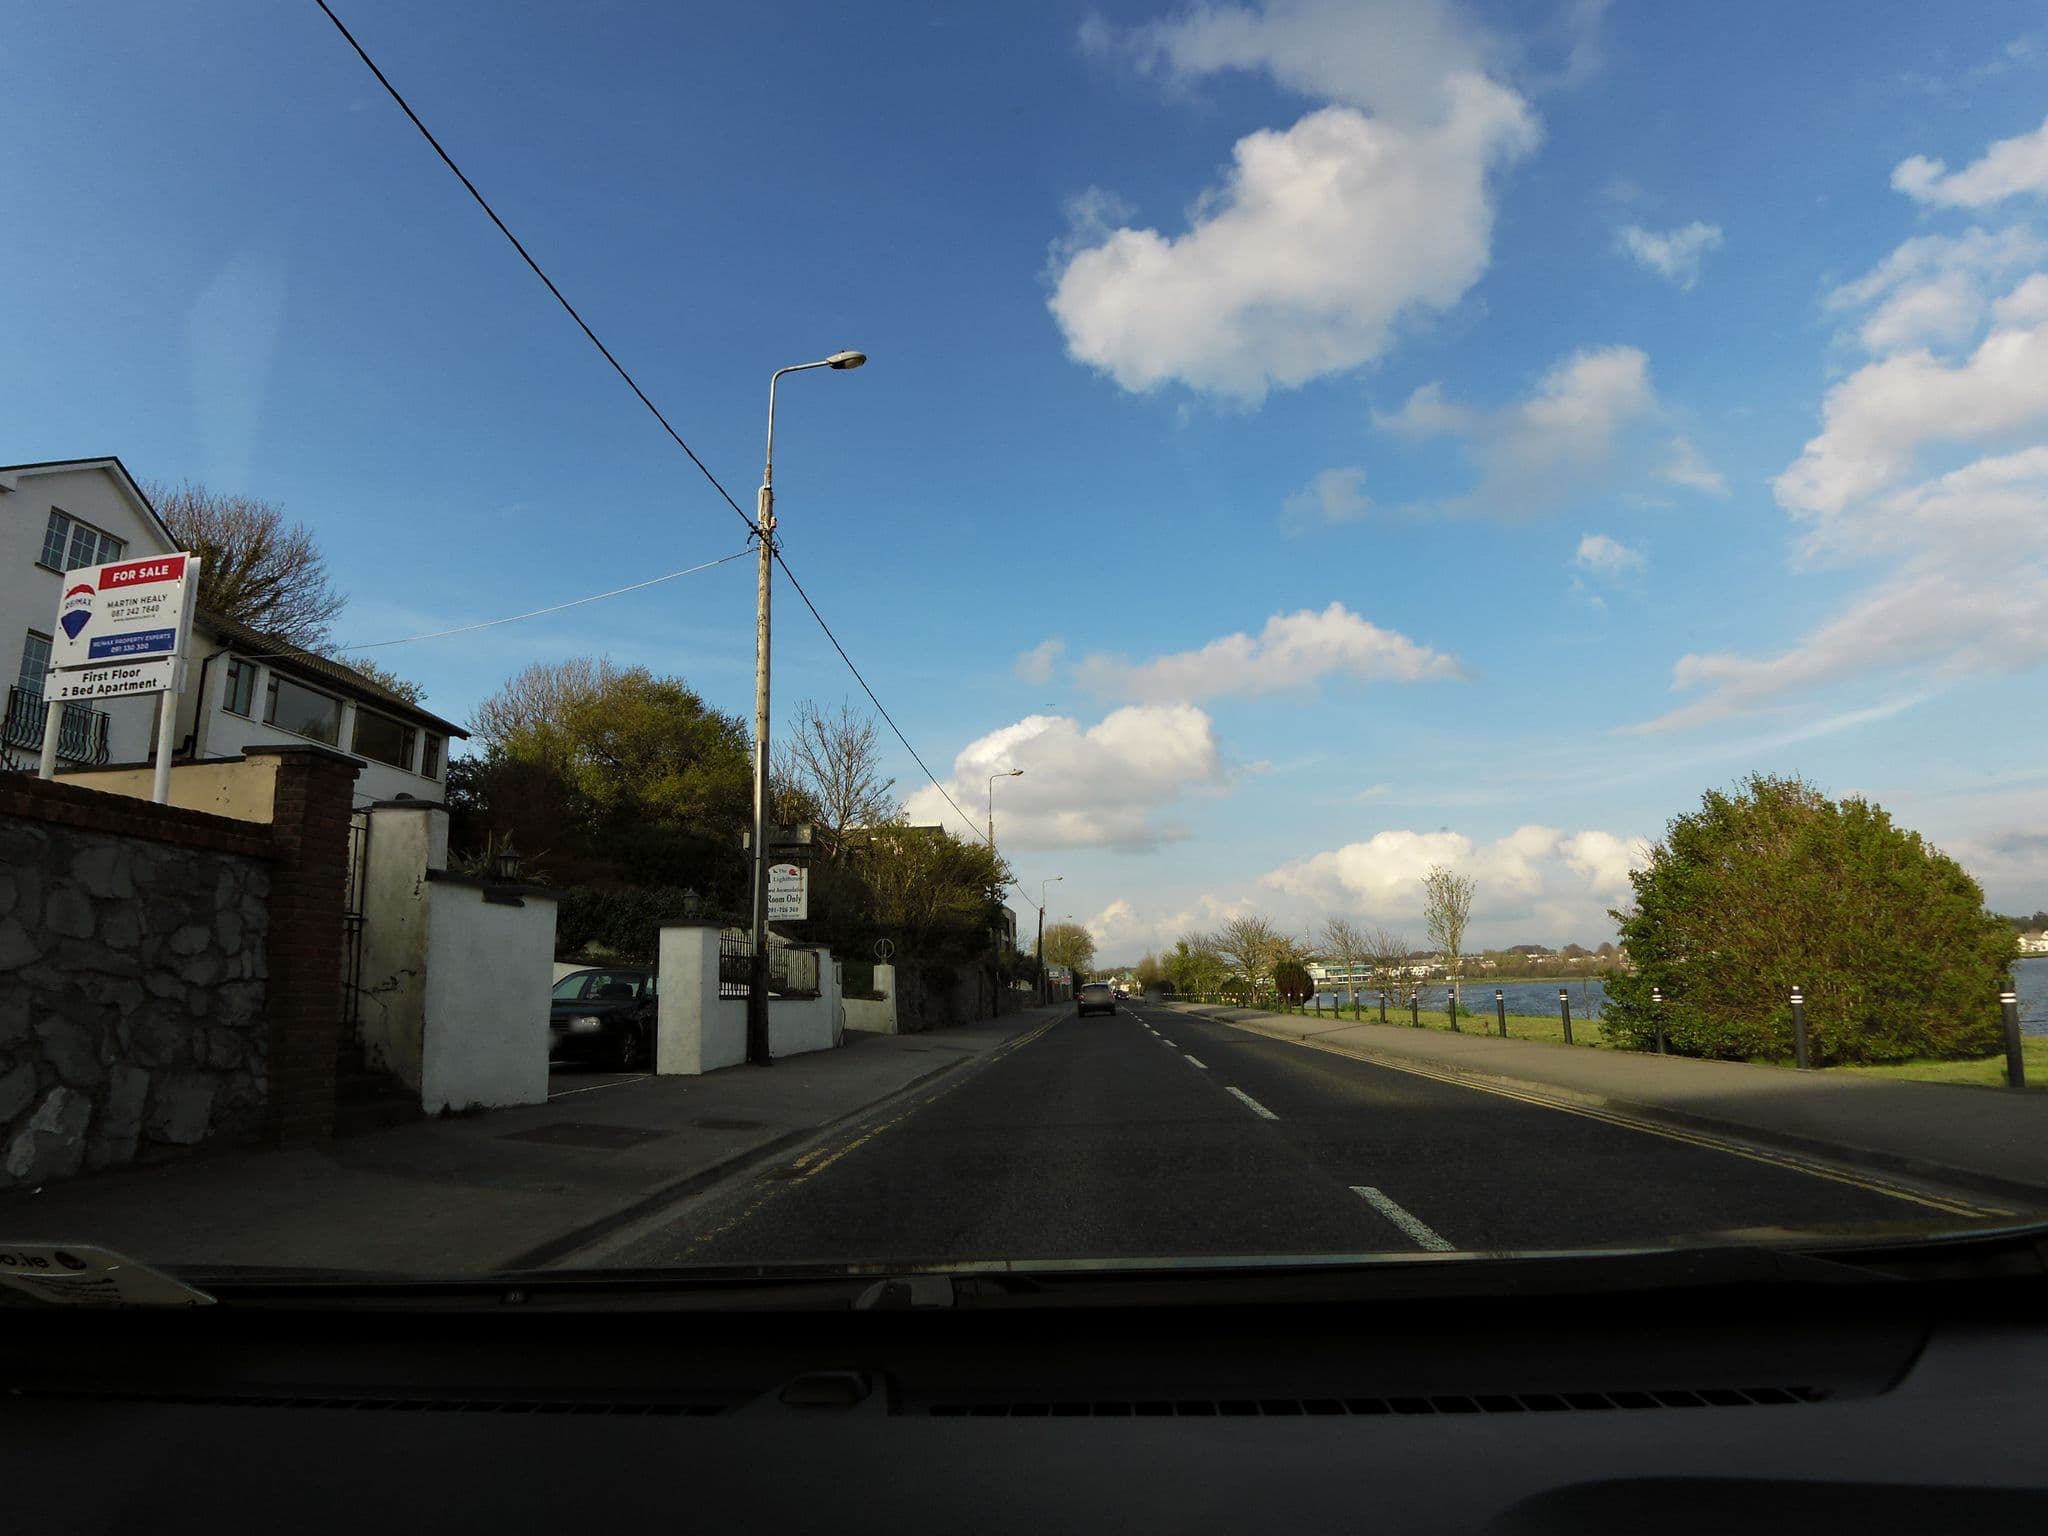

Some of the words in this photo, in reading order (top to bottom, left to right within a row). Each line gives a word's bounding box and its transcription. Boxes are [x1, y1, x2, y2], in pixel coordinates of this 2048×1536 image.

[113, 570, 136, 582] FOR
[139, 565, 169, 578] SALE
[107, 598, 138, 608] MARTIN
[140, 594, 168, 604] HEALY
[82, 672, 108, 683] First
[112, 668, 141, 679] Floor
[61, 687, 68, 696] 2
[72, 684, 94, 696] Bed
[97, 678, 157, 695] Apartment
[787, 894, 801, 904] Only
